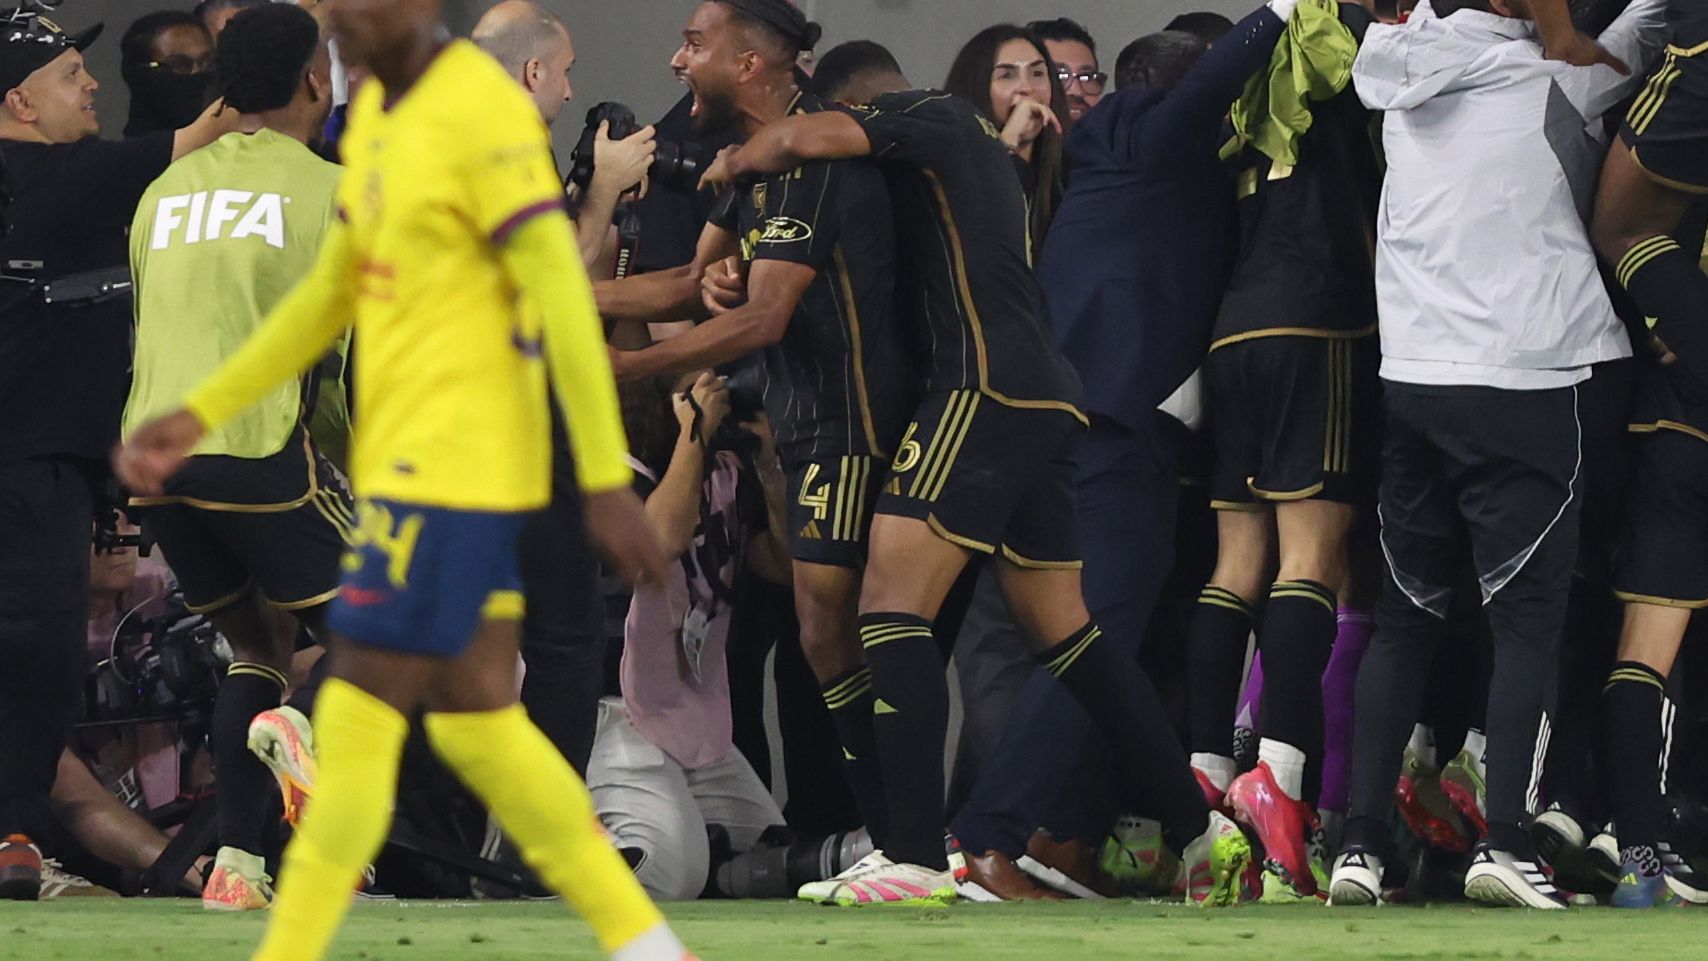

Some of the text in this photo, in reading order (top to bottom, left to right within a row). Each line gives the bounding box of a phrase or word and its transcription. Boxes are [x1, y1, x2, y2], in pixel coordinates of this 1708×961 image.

[151, 189, 285, 250] FIFA
[616, 248, 630, 280] non
[891, 421, 921, 473] 6
[798, 463, 831, 520] 4
